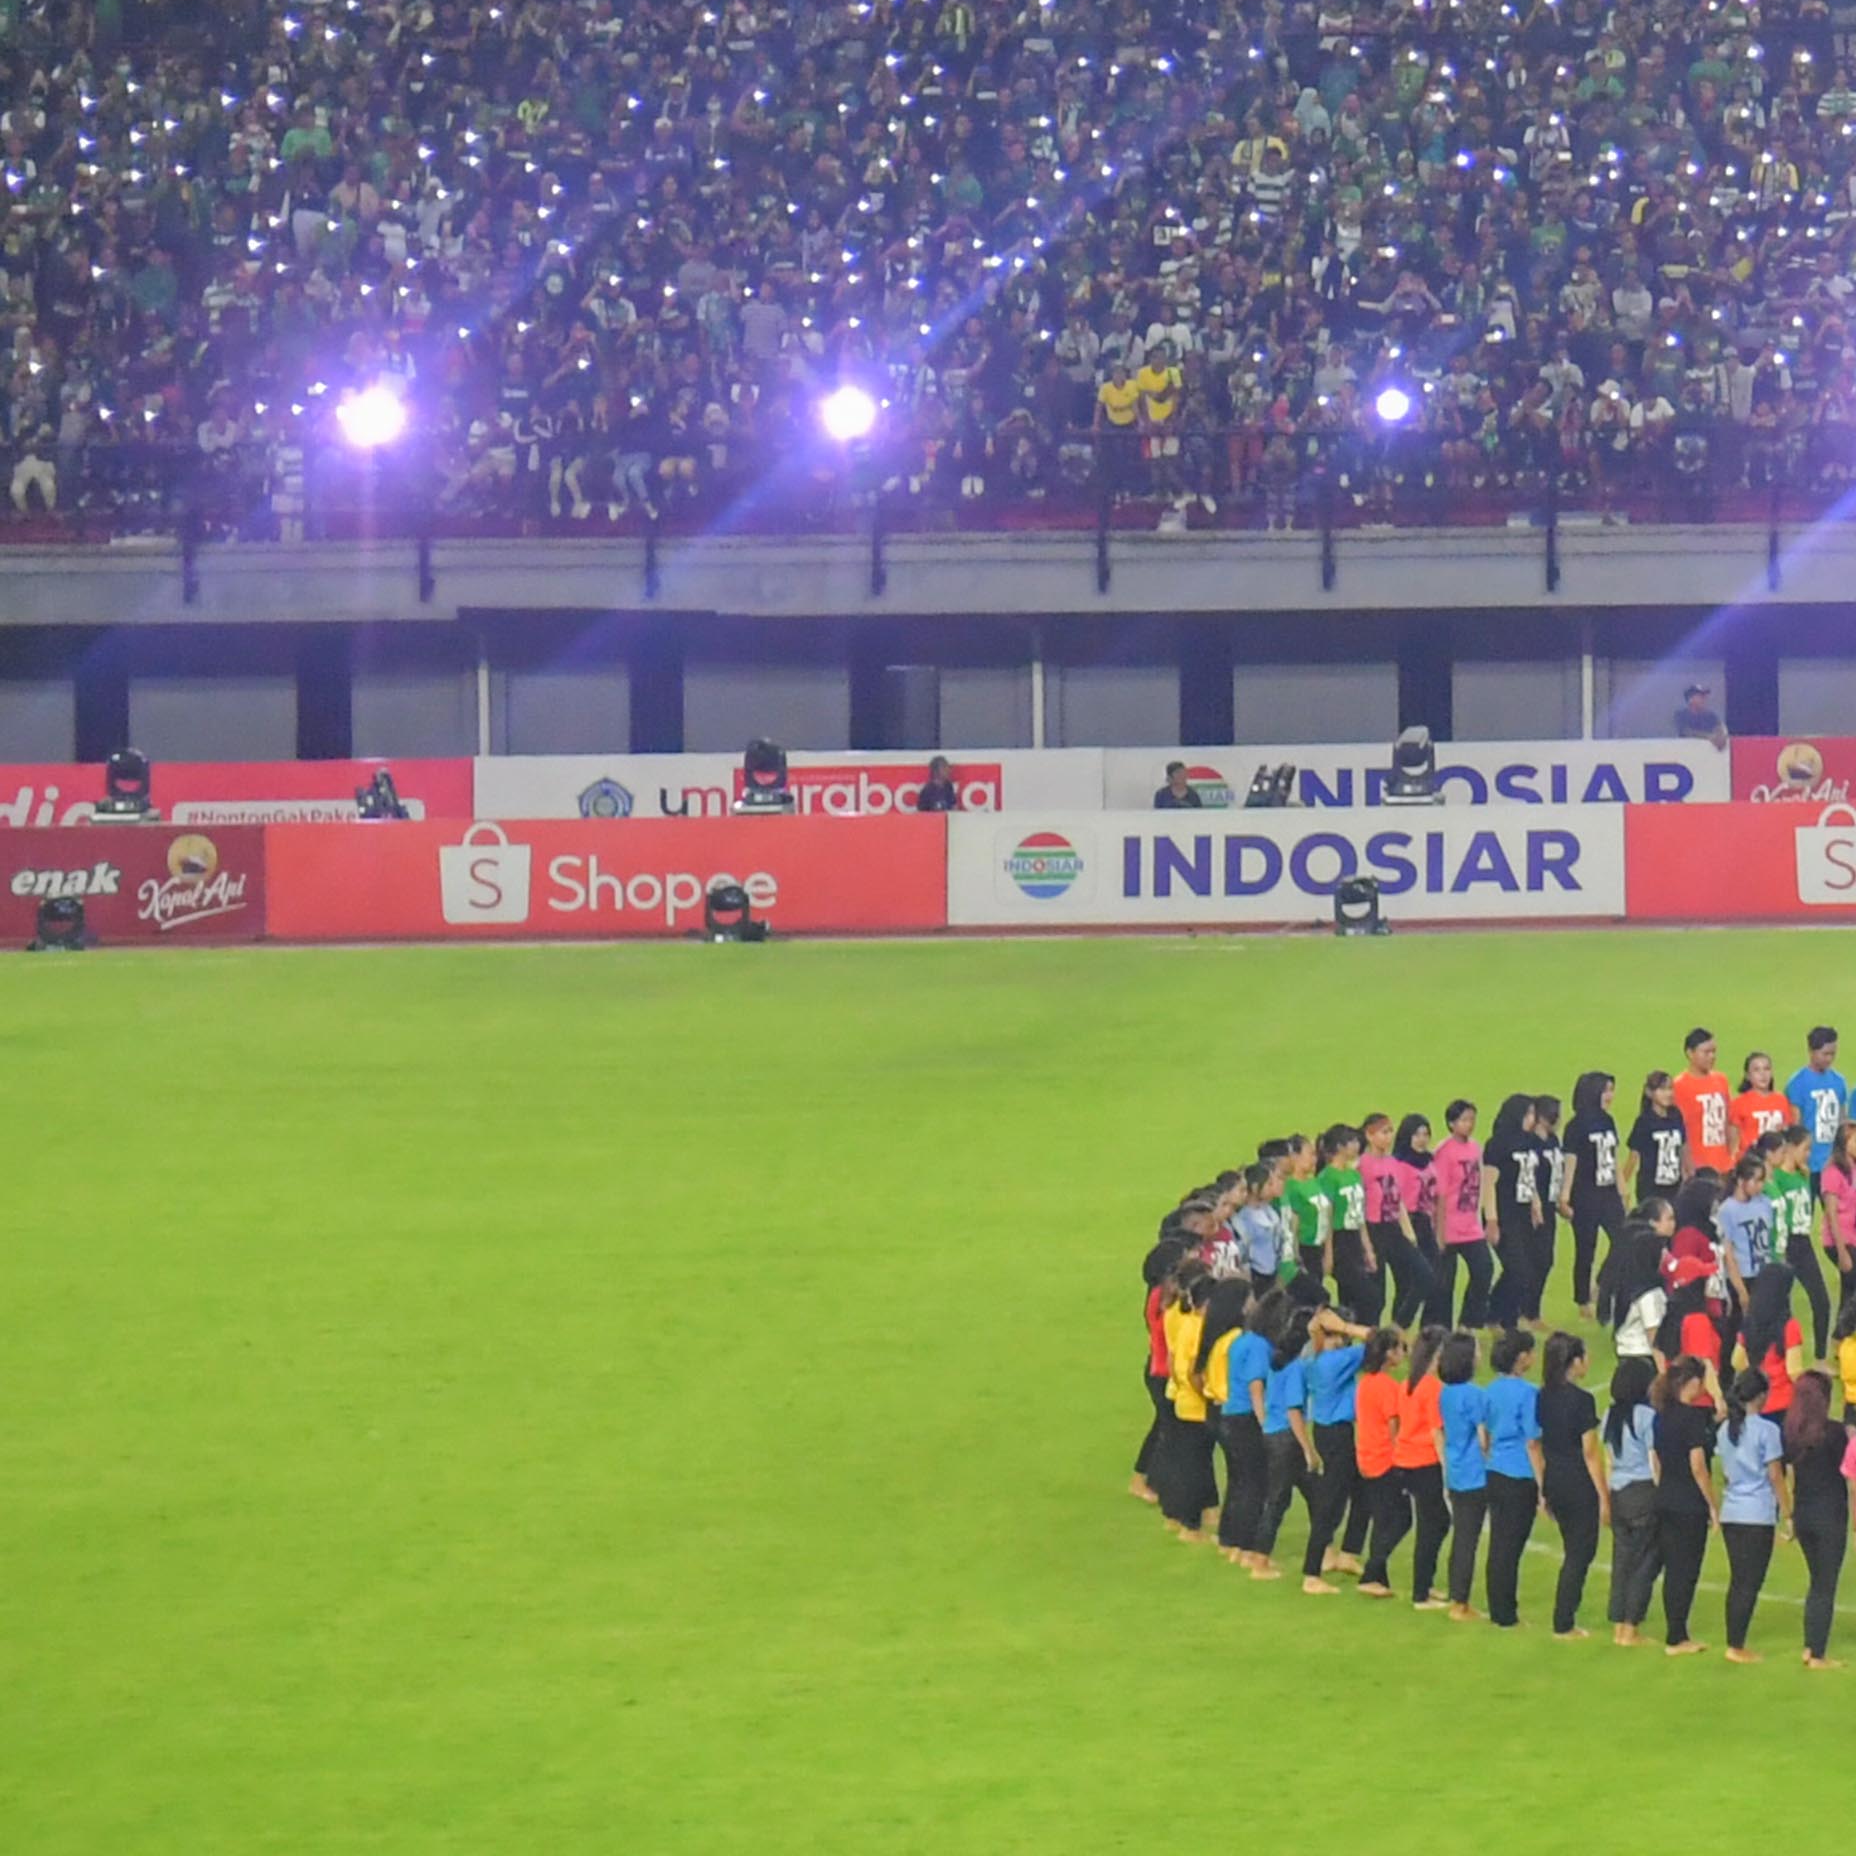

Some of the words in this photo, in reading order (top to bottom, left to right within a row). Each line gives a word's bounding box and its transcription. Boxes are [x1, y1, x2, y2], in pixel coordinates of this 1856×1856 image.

[10, 860, 123, 900] enak
[1005, 857, 1084, 873] INDOSIAR
[1122, 829, 1583, 898] INDOSIAR
